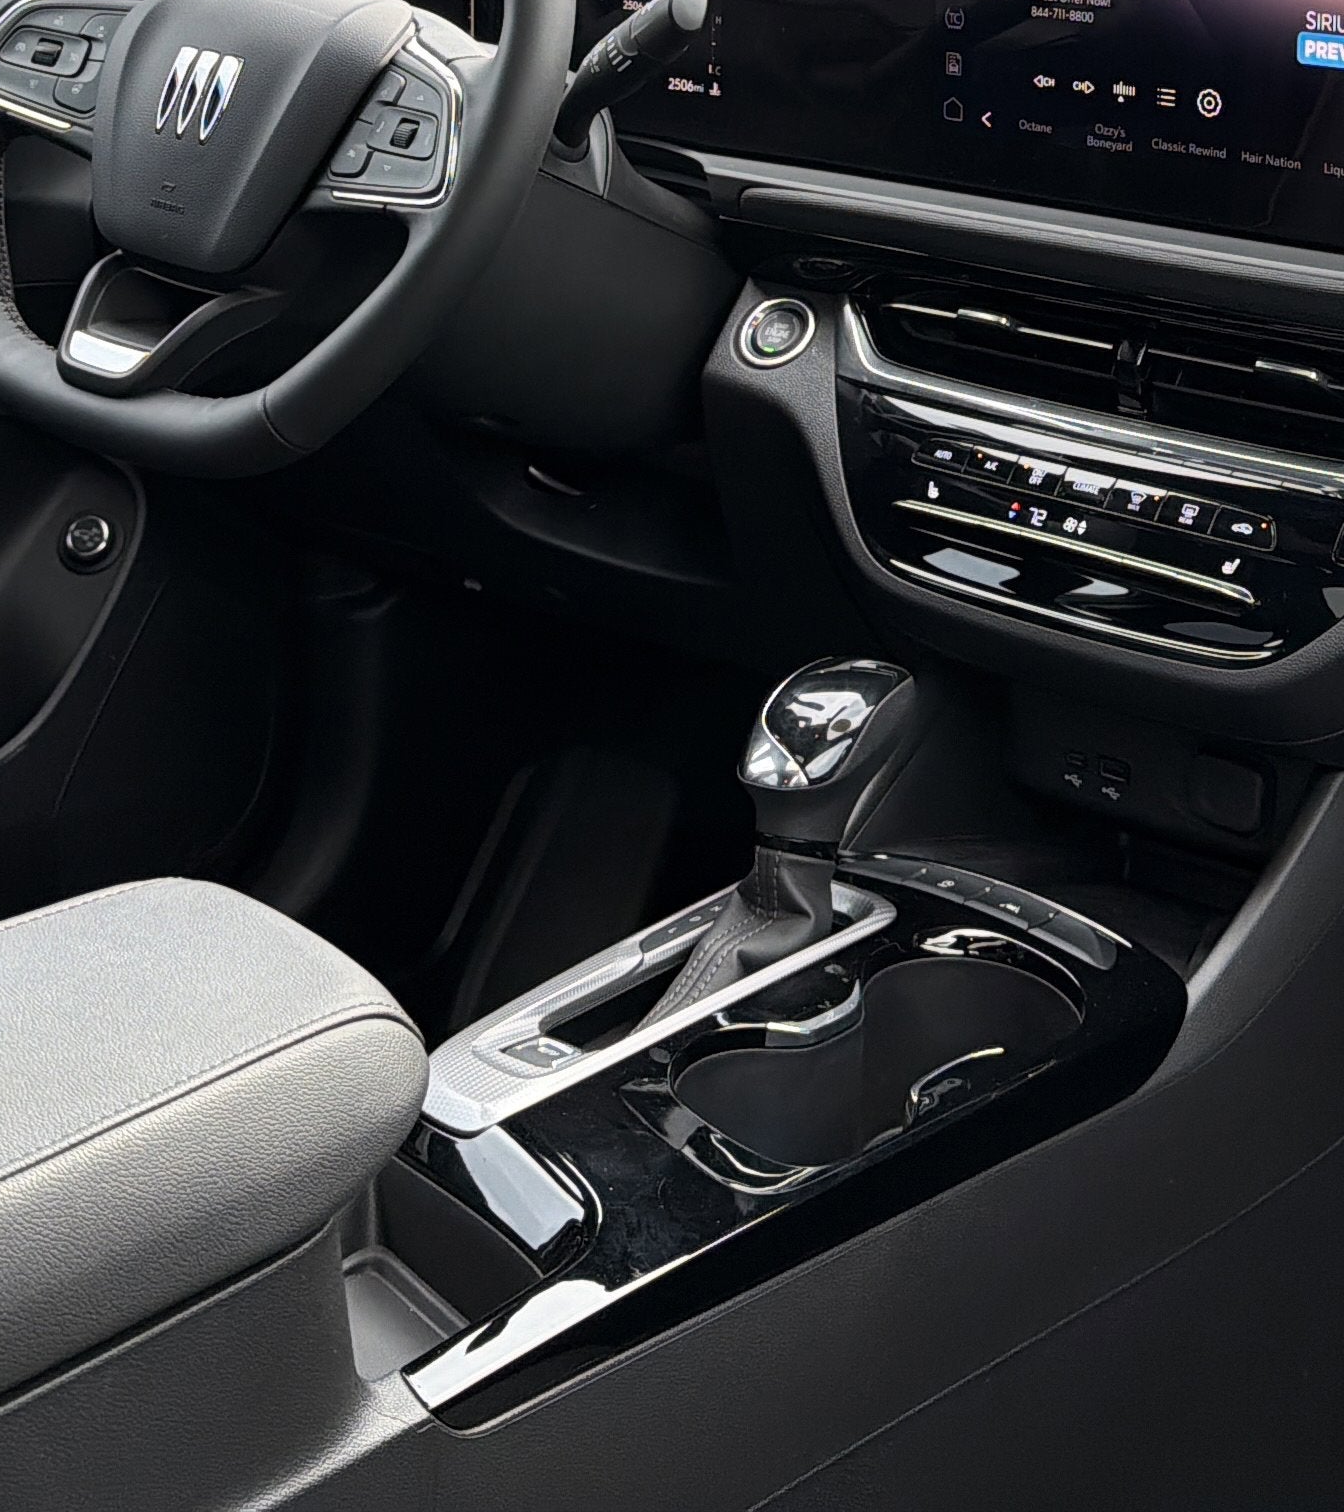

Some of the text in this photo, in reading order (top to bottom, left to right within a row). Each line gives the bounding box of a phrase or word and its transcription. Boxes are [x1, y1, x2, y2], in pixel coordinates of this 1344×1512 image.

[1031, 5, 1095, 24] 844-711-8800
[1018, 119, 1053, 134] Octane
[1094, 123, 1126, 139] Ozzy's
[1086, 135, 1133, 153] Boneyard
[1151, 138, 1227, 160] Classic Rewind
[1241, 150, 1302, 170] Hair Nation
[933, 449, 953, 461] AUTO
[984, 460, 1000, 471] A/C
[1028, 476, 1044, 486] OFF
[1072, 481, 1100, 496] CLIMATE
[1029, 506, 1048, 527] 72
